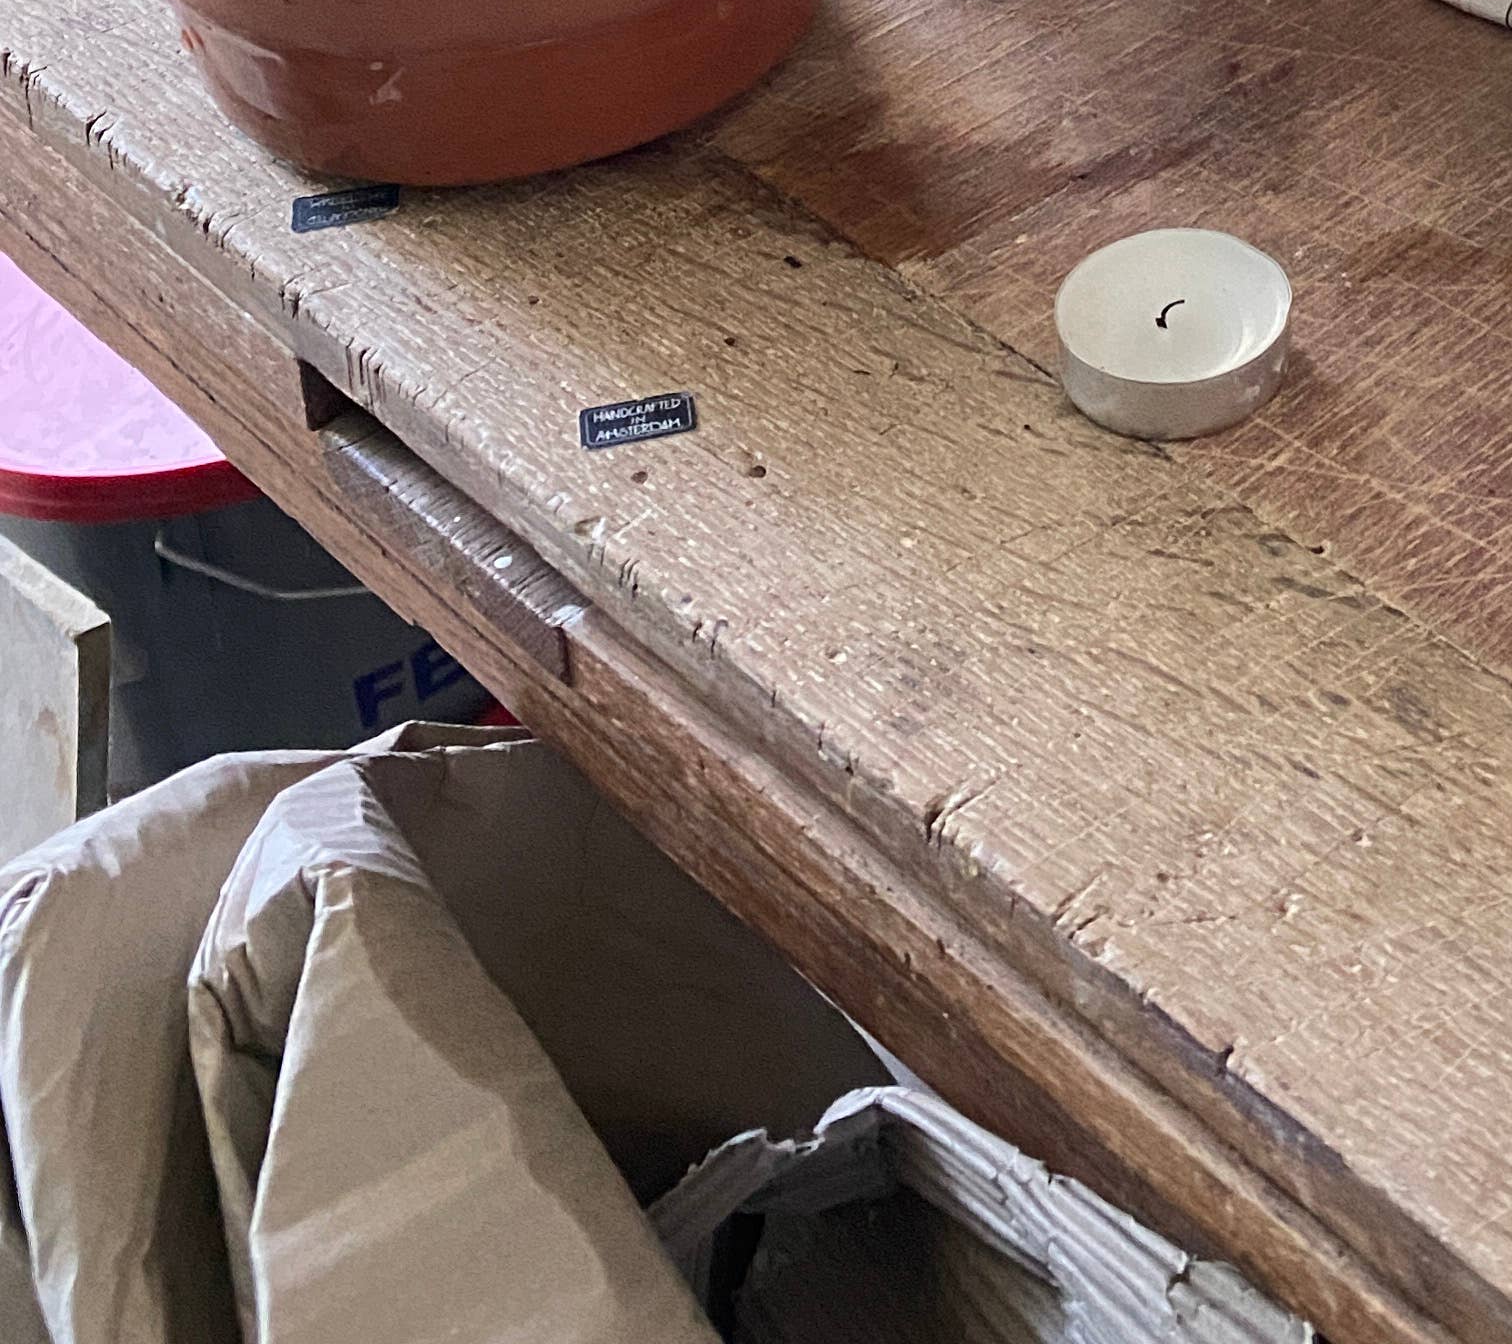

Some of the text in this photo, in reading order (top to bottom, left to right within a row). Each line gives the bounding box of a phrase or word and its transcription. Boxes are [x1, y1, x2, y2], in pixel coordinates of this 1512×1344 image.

[593, 398, 681, 423] HANDCRAFTED
[630, 415, 647, 425] IN
[595, 417, 681, 442] AMSTERDAM
